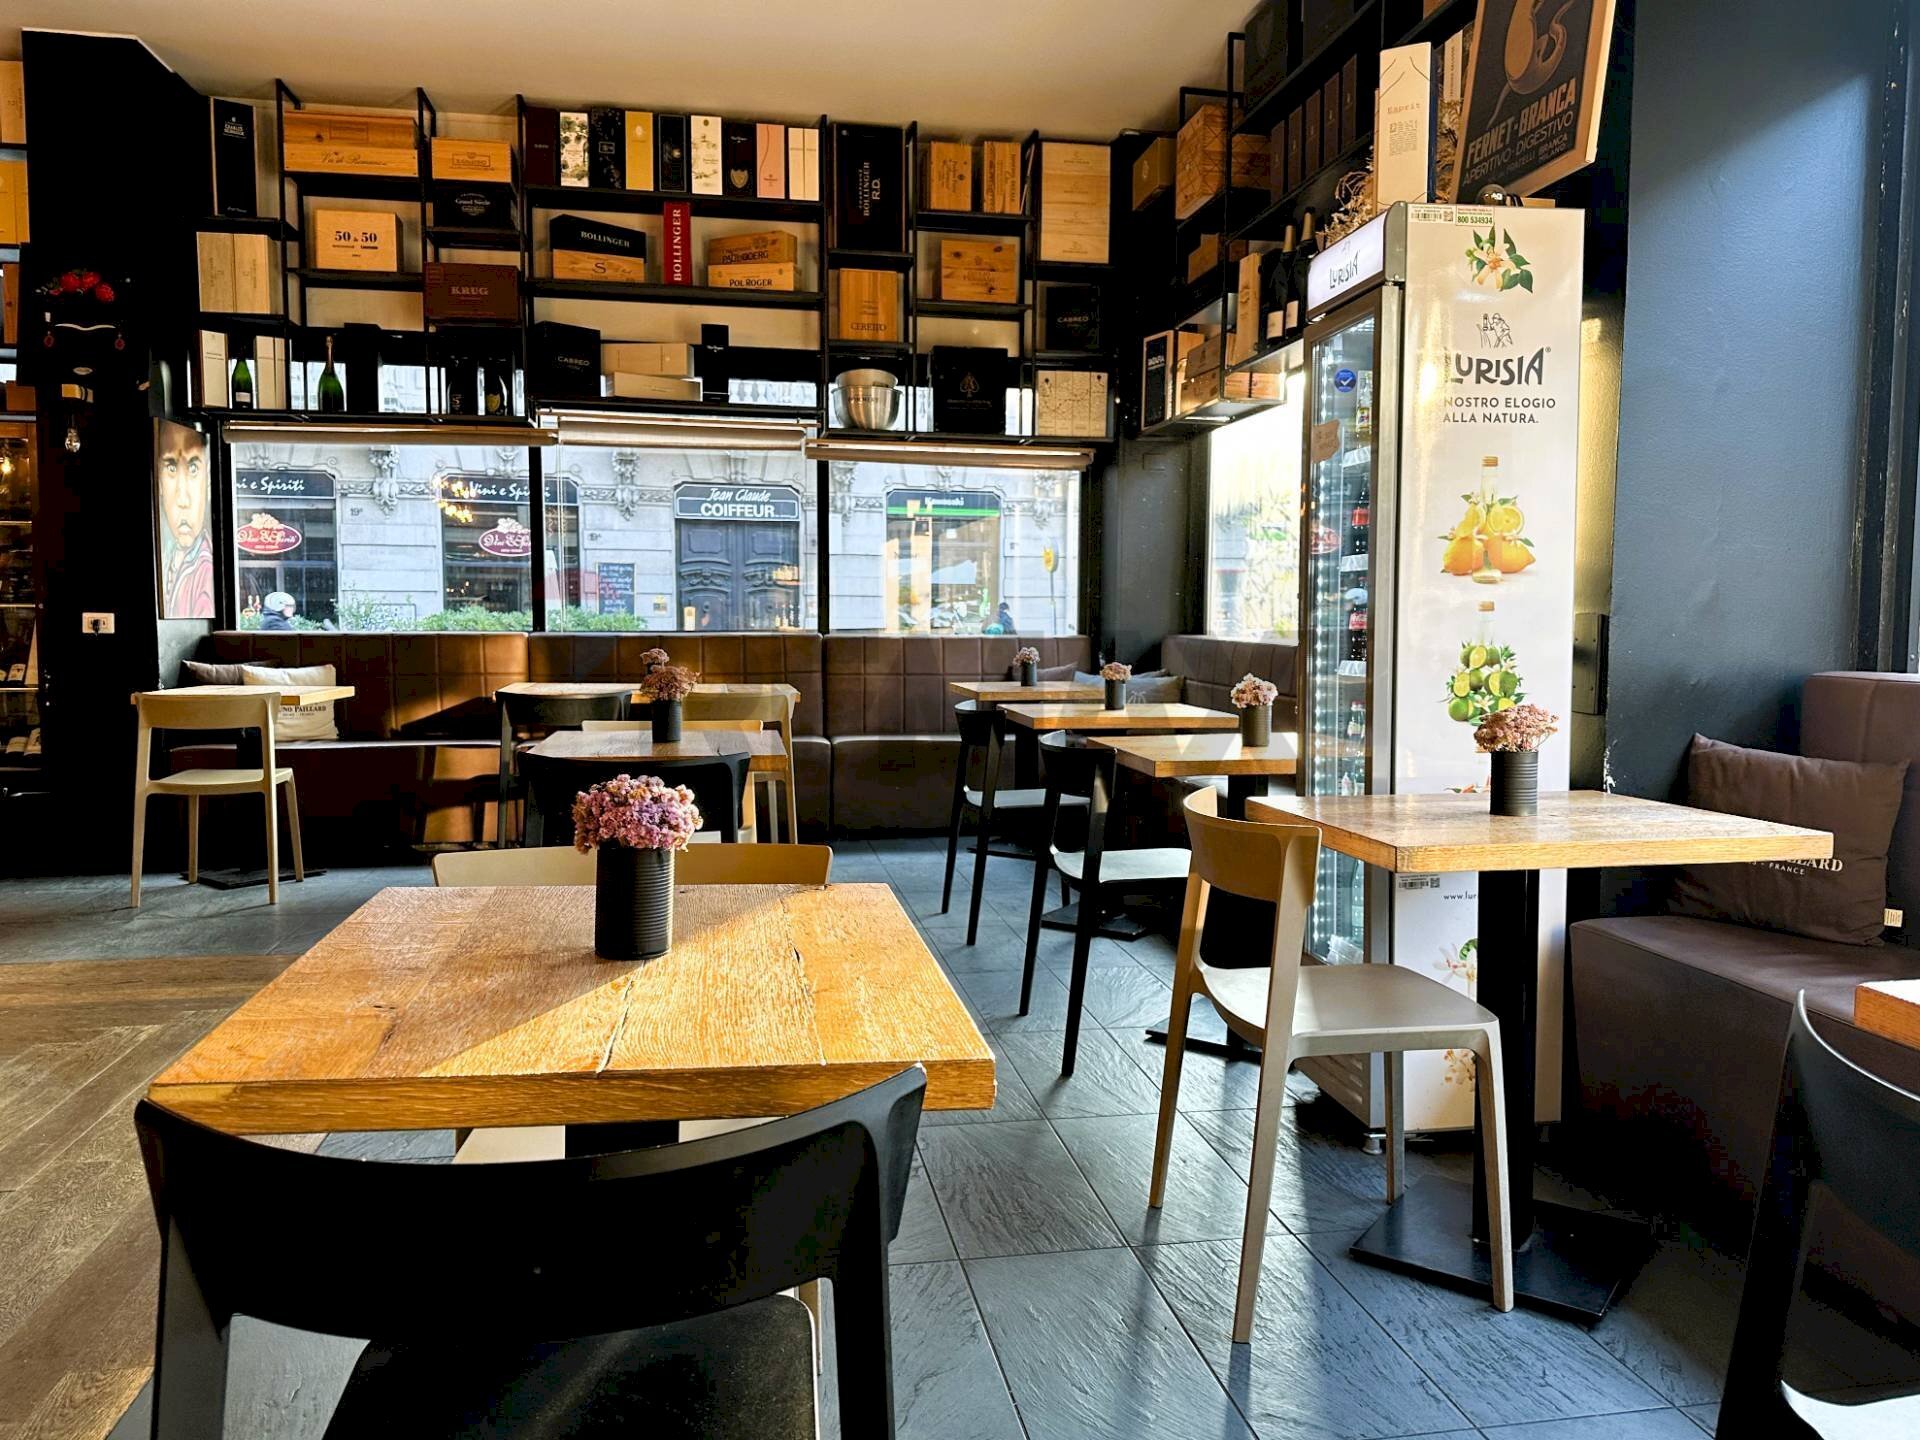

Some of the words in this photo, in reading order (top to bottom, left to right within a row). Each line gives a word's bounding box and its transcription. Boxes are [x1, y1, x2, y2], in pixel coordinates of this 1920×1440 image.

[863, 162, 871, 217] BOLLINGER
[1457, 215, 1470, 224] 800
[1470, 216, 1493, 225] 534934
[334, 231, 352, 242] 50
[361, 232, 378, 243] 50
[580, 230, 630, 249] BOLLINGER
[672, 208, 683, 282] BOLLINGER
[729, 278, 744, 288] POL
[745, 279, 773, 287] ROGER
[450, 286, 489, 296] KRUG
[1443, 397, 1500, 409] NOSTRO
[1504, 397, 1557, 409] ELOGIO
[1442, 412, 1478, 424] ALLA
[1481, 412, 1540, 424] NATURA.
[249, 481, 258, 490] e
[260, 475, 305, 495] Spiriti
[499, 487, 507, 496] e
[706, 487, 735, 501] Jean
[735, 488, 772, 503] Claude
[700, 502, 776, 518] COIFFEUR
[294, 704, 327, 713] PAILLARD
[1768, 861, 1806, 876] FRANCE
[1442, 890, 1478, 901] www.lur
